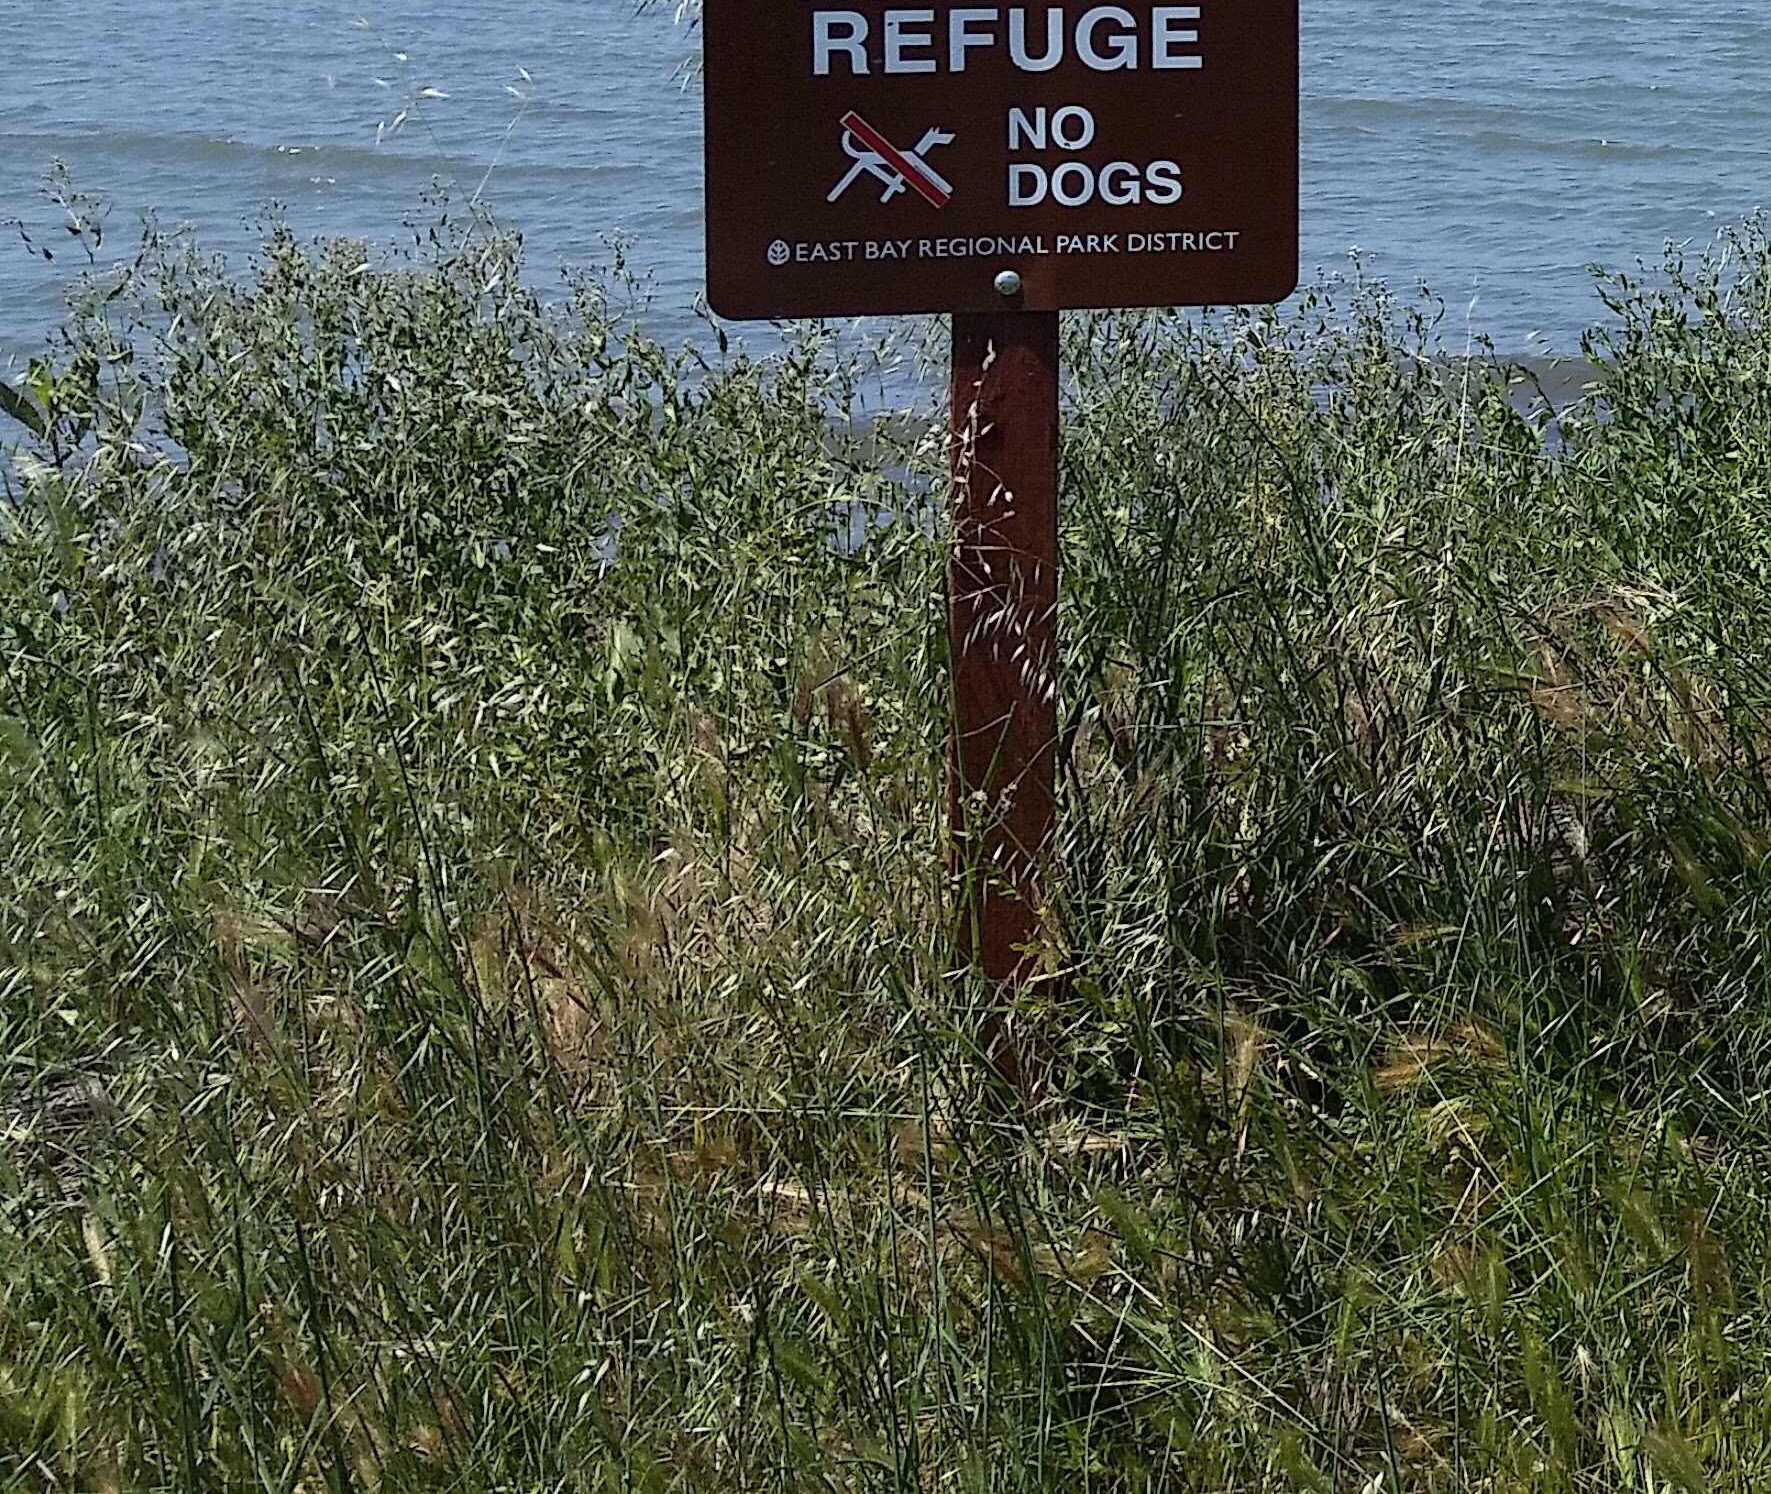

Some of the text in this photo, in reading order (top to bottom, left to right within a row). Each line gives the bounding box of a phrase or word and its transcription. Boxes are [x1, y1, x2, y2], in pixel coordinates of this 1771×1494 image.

[812, 6, 1202, 75] REFUGE
[1008, 106, 1095, 150] NO
[1008, 160, 1183, 207] DOGS
[795, 232, 1240, 261] EAST BAY REGIONAL PARK DISTRICT
